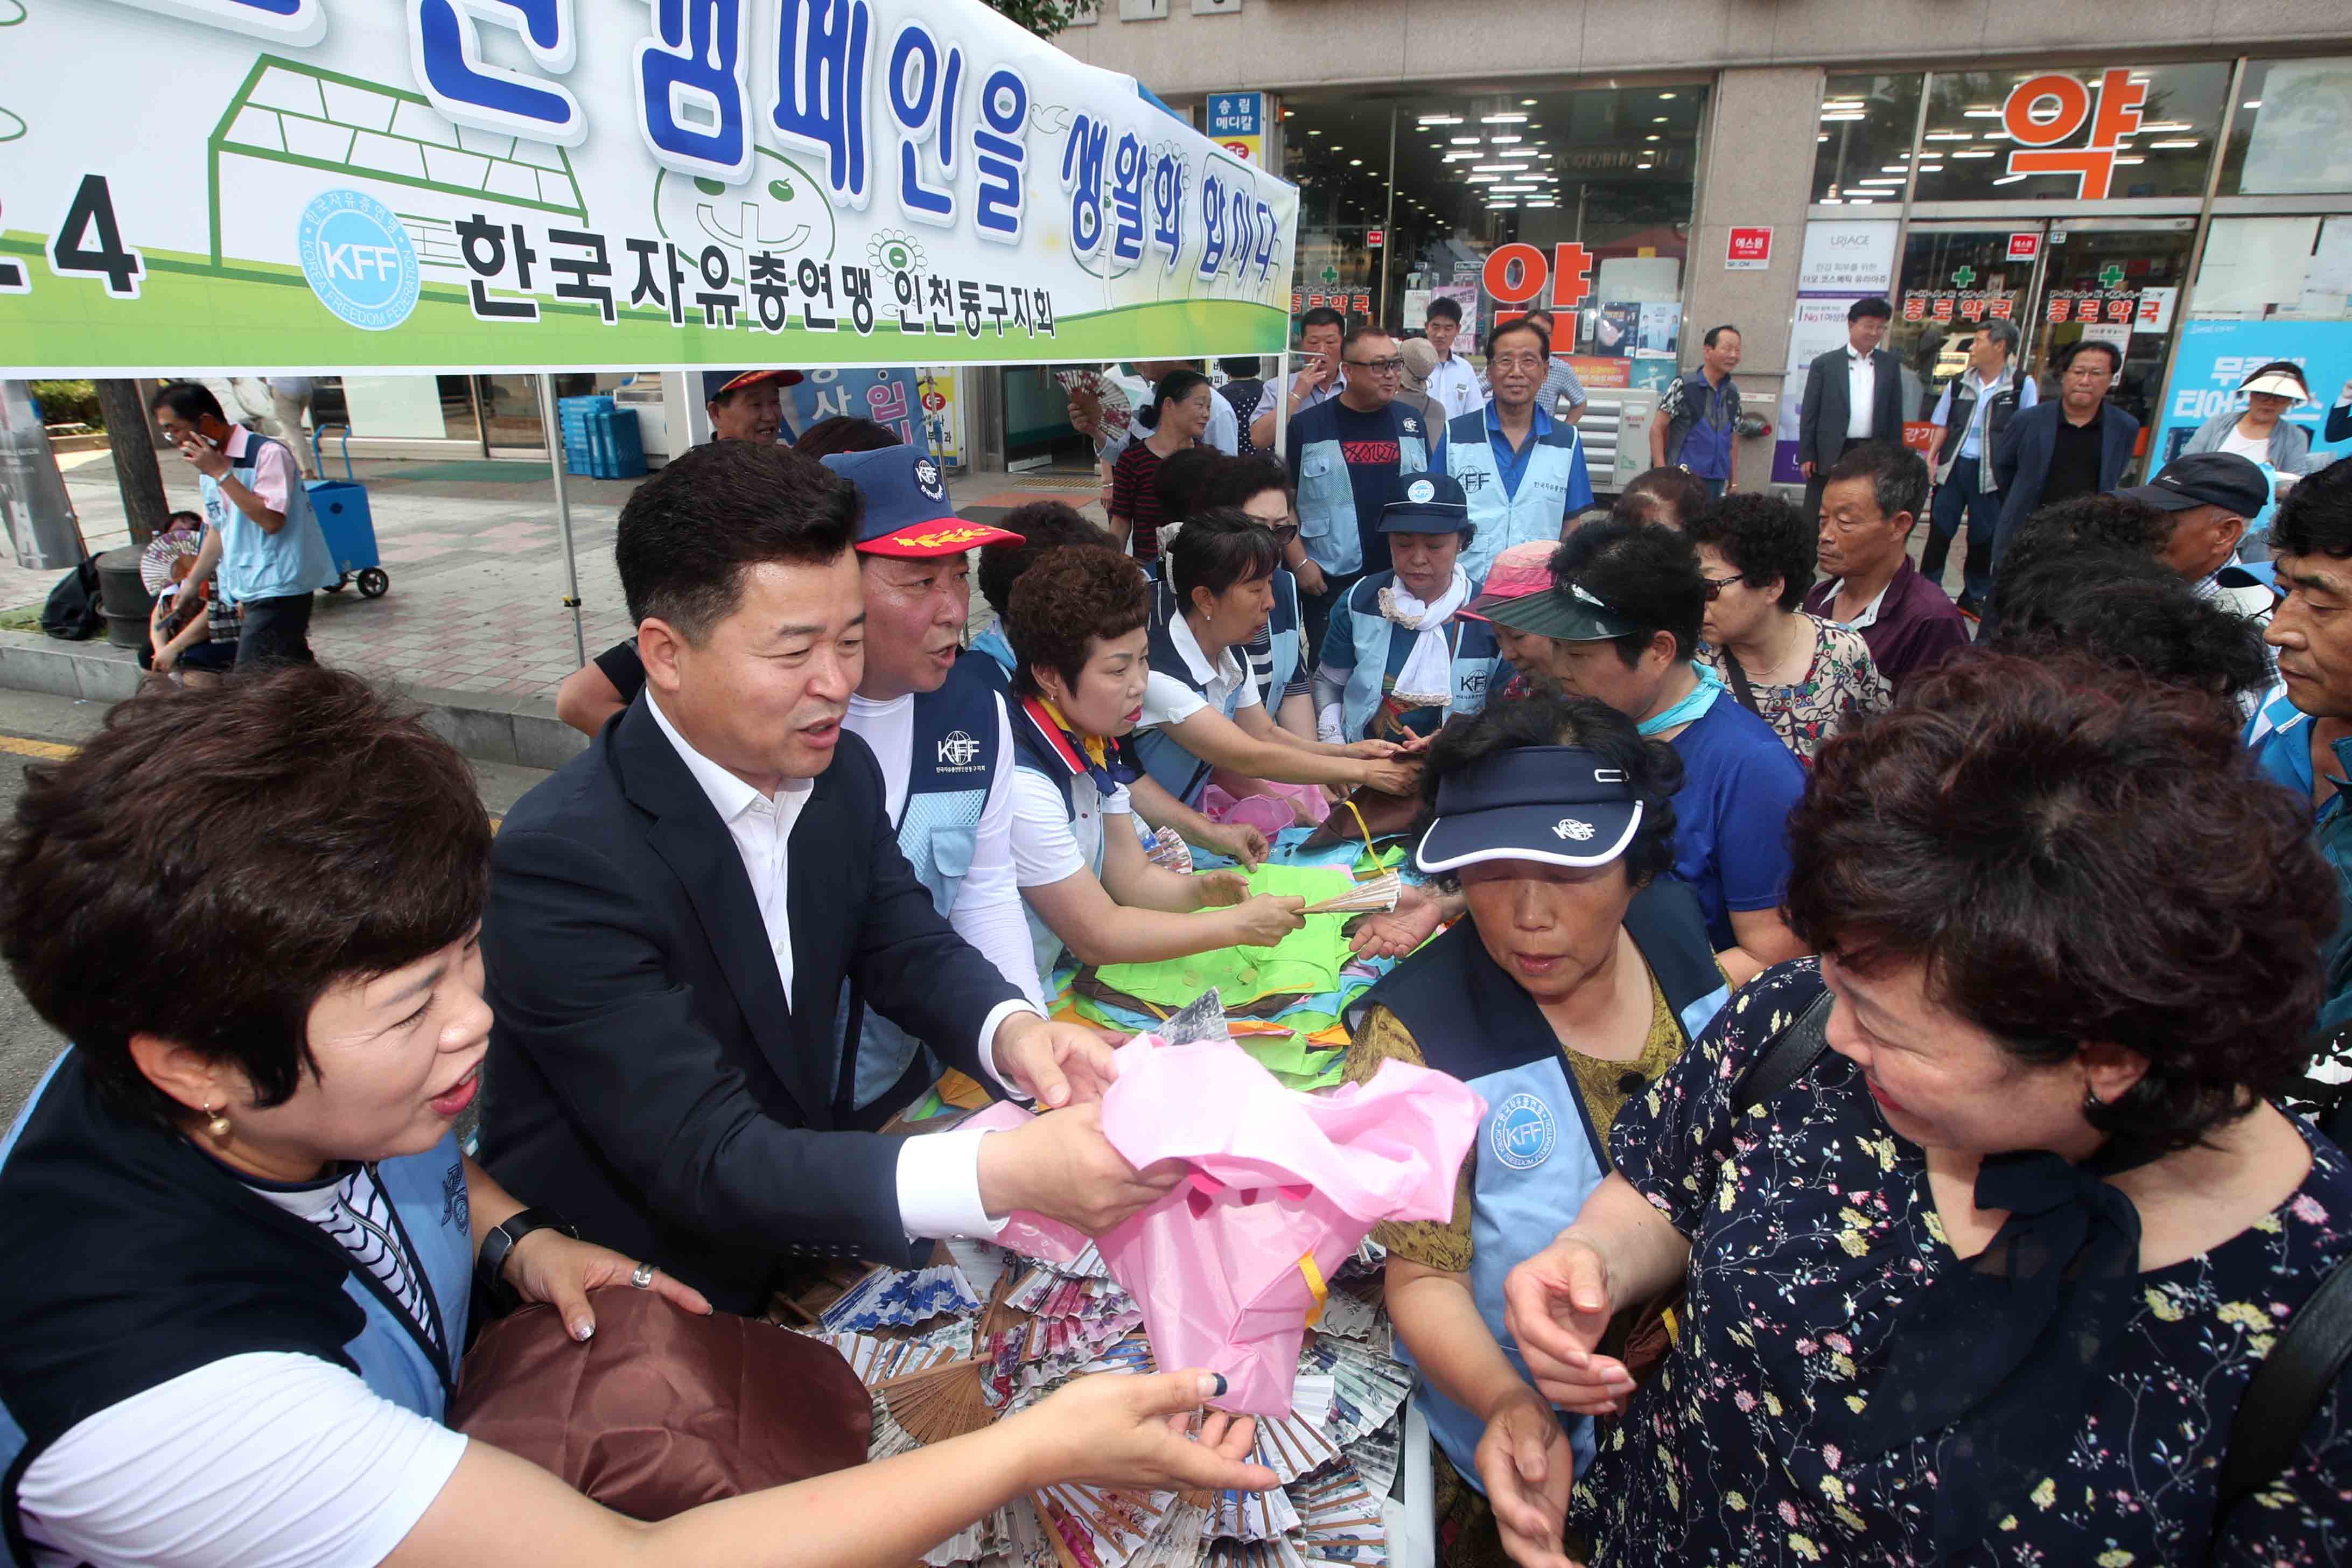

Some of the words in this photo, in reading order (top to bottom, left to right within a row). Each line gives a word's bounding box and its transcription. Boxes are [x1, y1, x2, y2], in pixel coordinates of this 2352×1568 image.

[2001, 67, 2150, 199] 약
[1062, 113, 1182, 265] 생활화
[320, 241, 397, 283] KFF
[456, 214, 873, 337] 한국자유총연맹
[895, 270, 1055, 337] 인천동구지회
[301, 239, 327, 293] KOREA
[325, 292, 387, 326] FREEDOM
[387, 249, 415, 320] FEDERATION
[1903, 298, 2013, 323] 종로약국
[2047, 298, 2161, 324] 종로약국
[937, 740, 980, 762] KFF
[1551, 823, 1595, 839] KFF
[1506, 1121, 1543, 1149] KFF
